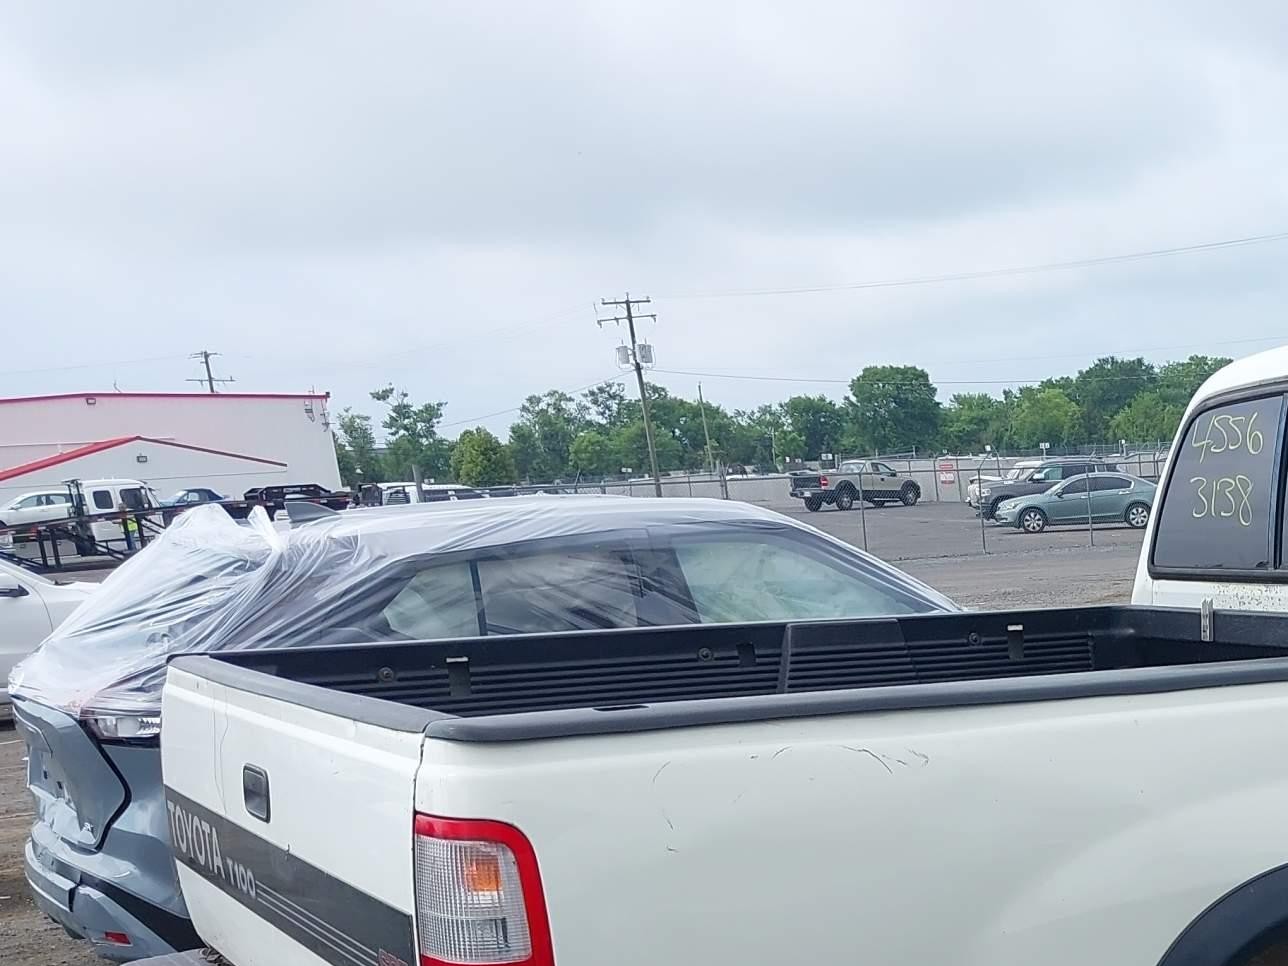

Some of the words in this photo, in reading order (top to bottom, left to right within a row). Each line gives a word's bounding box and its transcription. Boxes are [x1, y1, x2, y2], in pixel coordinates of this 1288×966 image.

[1191, 412, 1263, 464] 4556
[1190, 475, 1253, 526] 3138
[167, 800, 225, 880] TOYOTA
[226, 857, 256, 899] T100
